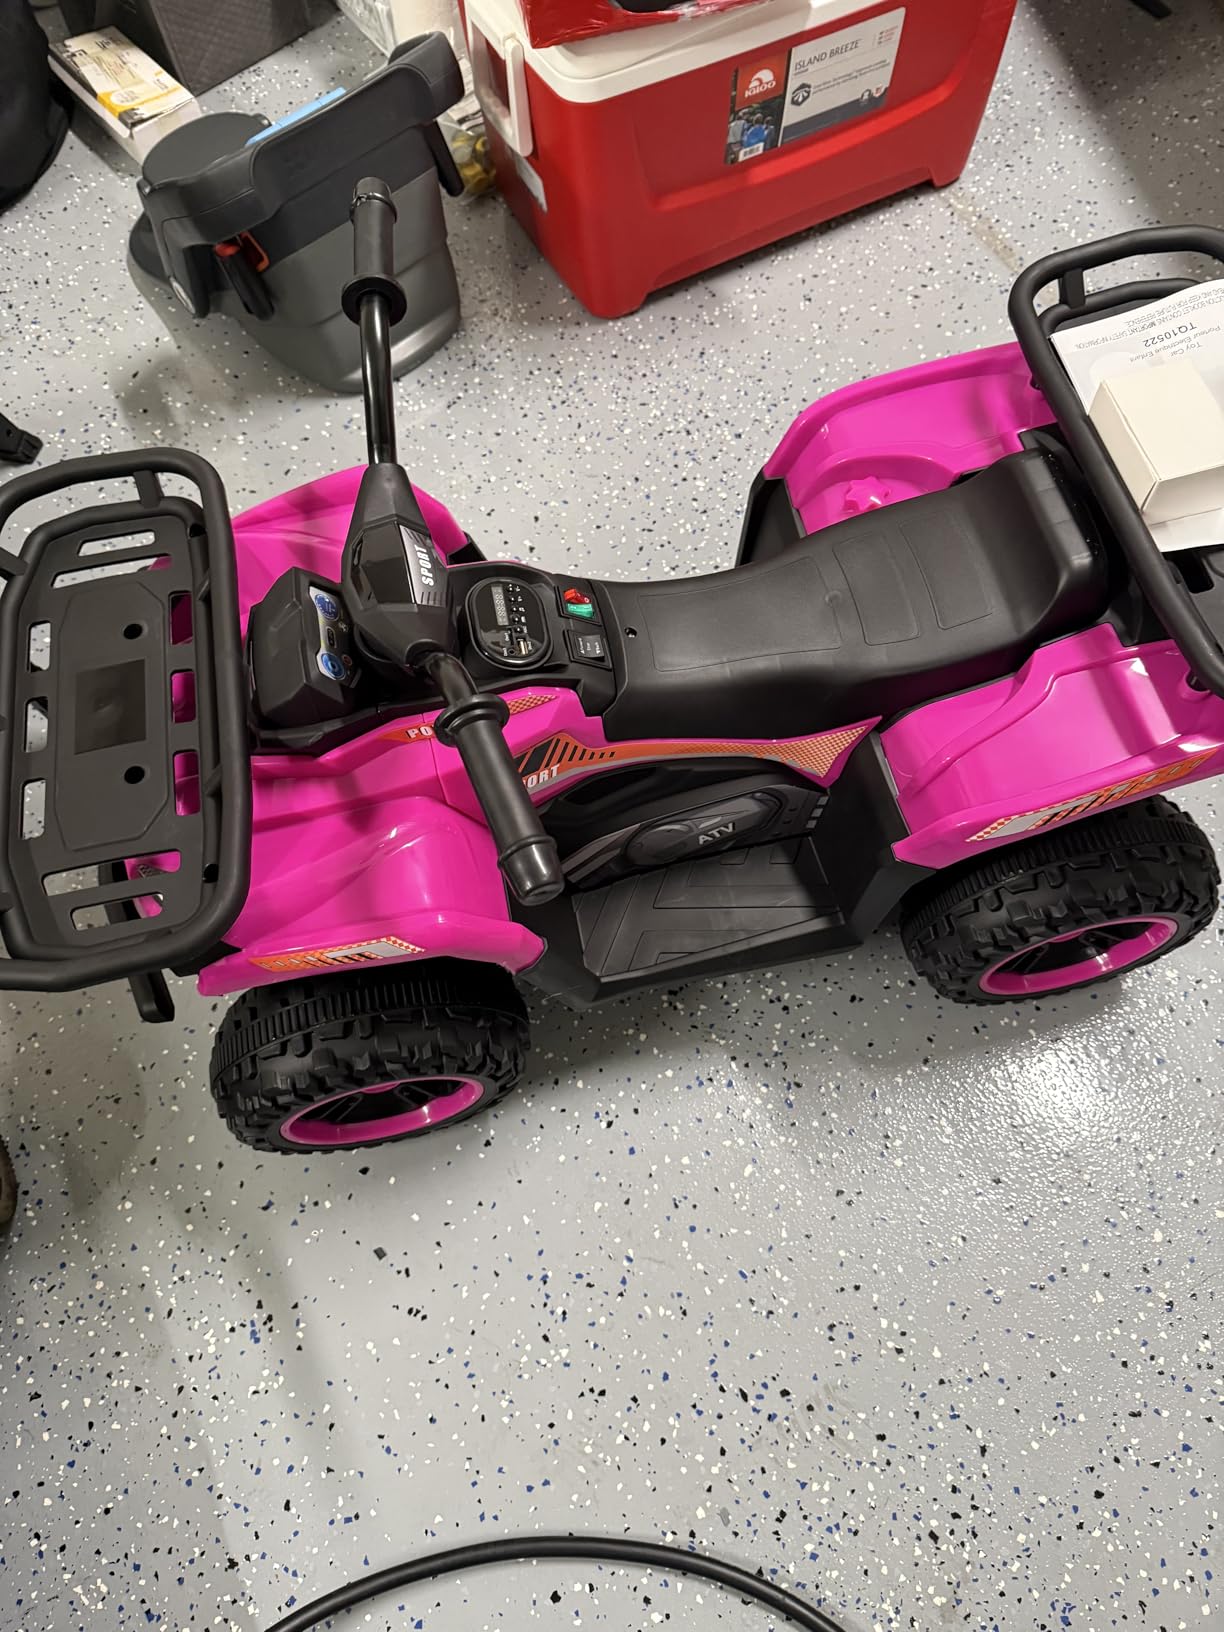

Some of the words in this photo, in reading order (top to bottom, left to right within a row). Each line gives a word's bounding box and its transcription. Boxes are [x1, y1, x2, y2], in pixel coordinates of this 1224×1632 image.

[794, 52, 827, 71] ISLAND
[829, 40, 859, 58] BREEZE
[1128, 320, 1156, 335] IMPORTANT
[1142, 322, 1198, 347] TQ10522
[1170, 348, 1185, 357] Car
[1186, 342, 1202, 350] Toy
[414, 544, 434, 586] SPORT
[406, 724, 434, 739] PO
[522, 763, 560, 788] ORT
[698, 822, 734, 845] ATV
